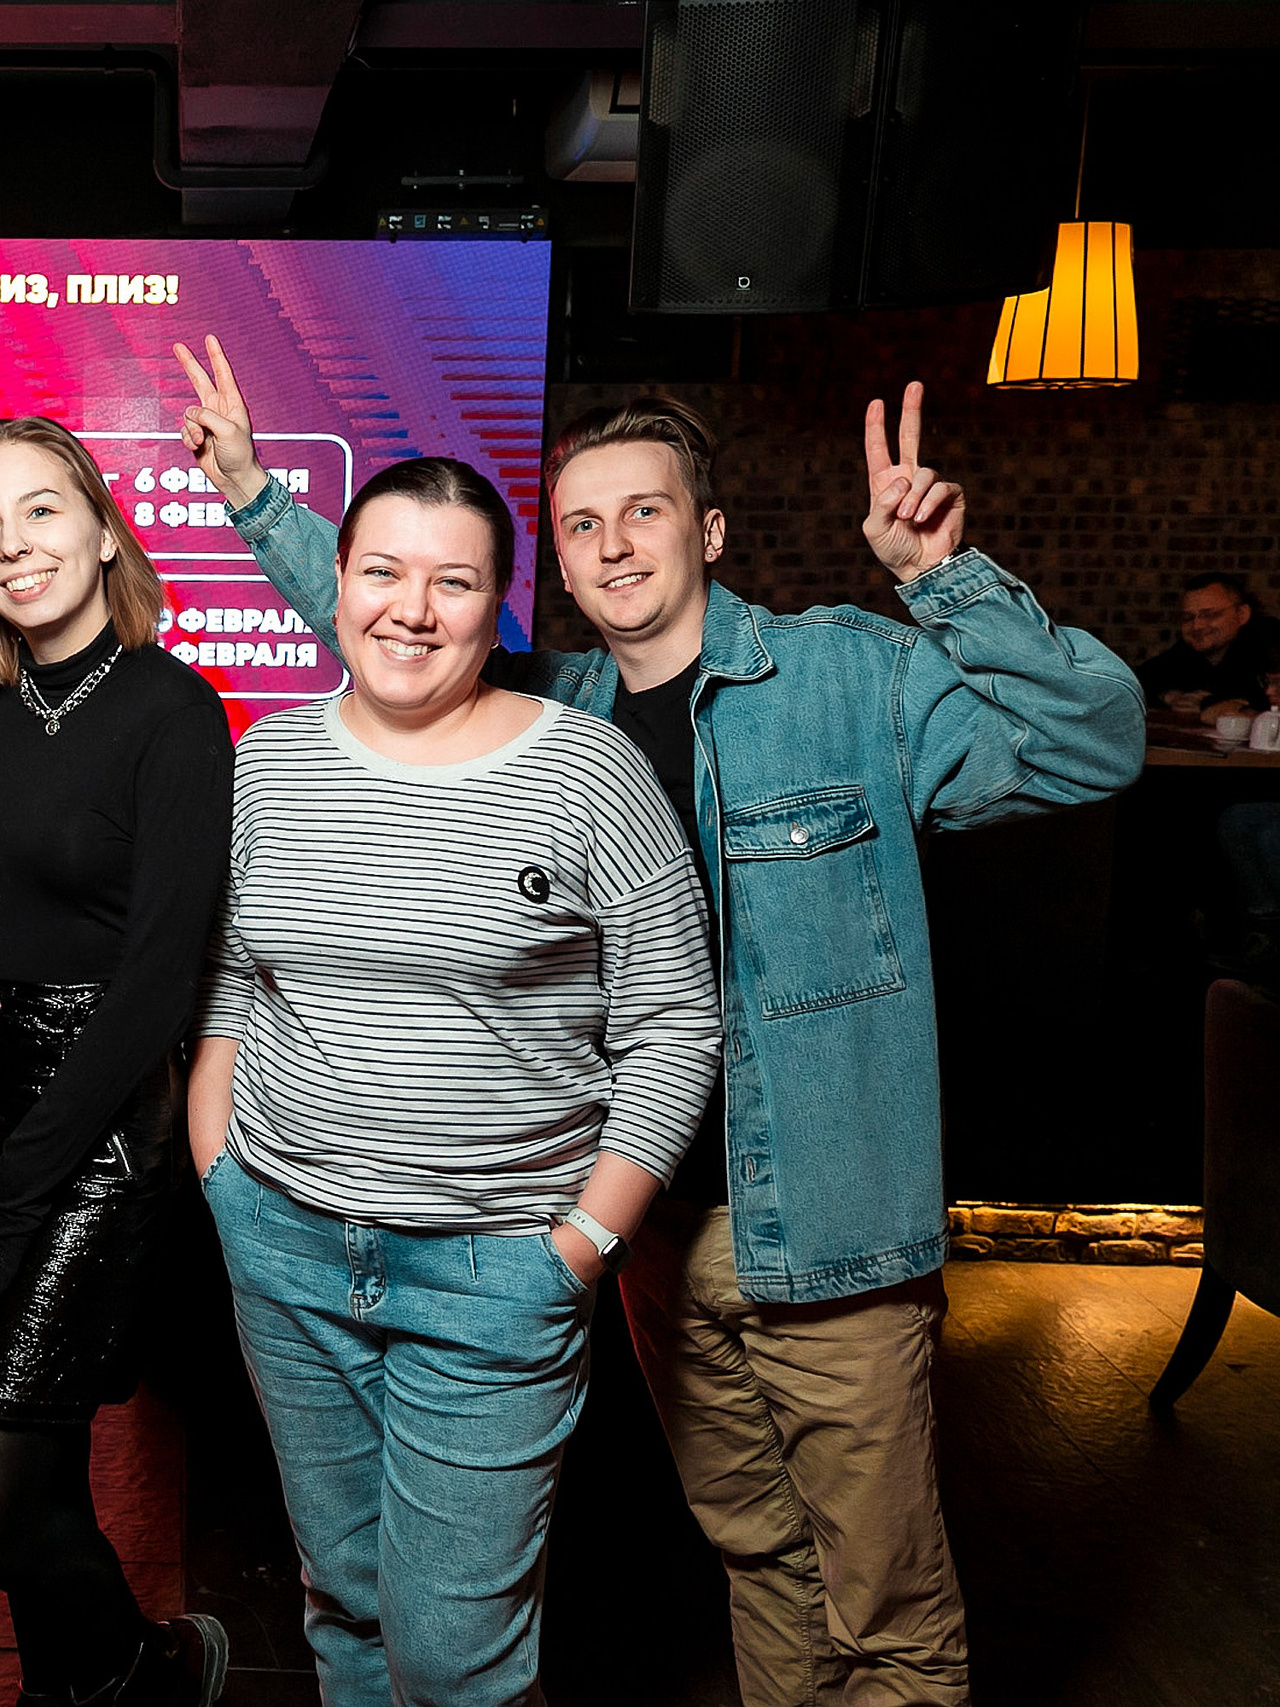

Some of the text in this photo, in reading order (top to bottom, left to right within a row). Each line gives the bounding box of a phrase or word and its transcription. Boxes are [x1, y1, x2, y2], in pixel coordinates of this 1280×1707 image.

[66, 274, 179, 305] ПЛИЗ!
[134, 467, 156, 493] 6
[134, 501, 156, 527] 8
[170, 641, 318, 667] ФЕВРАЛЯ
